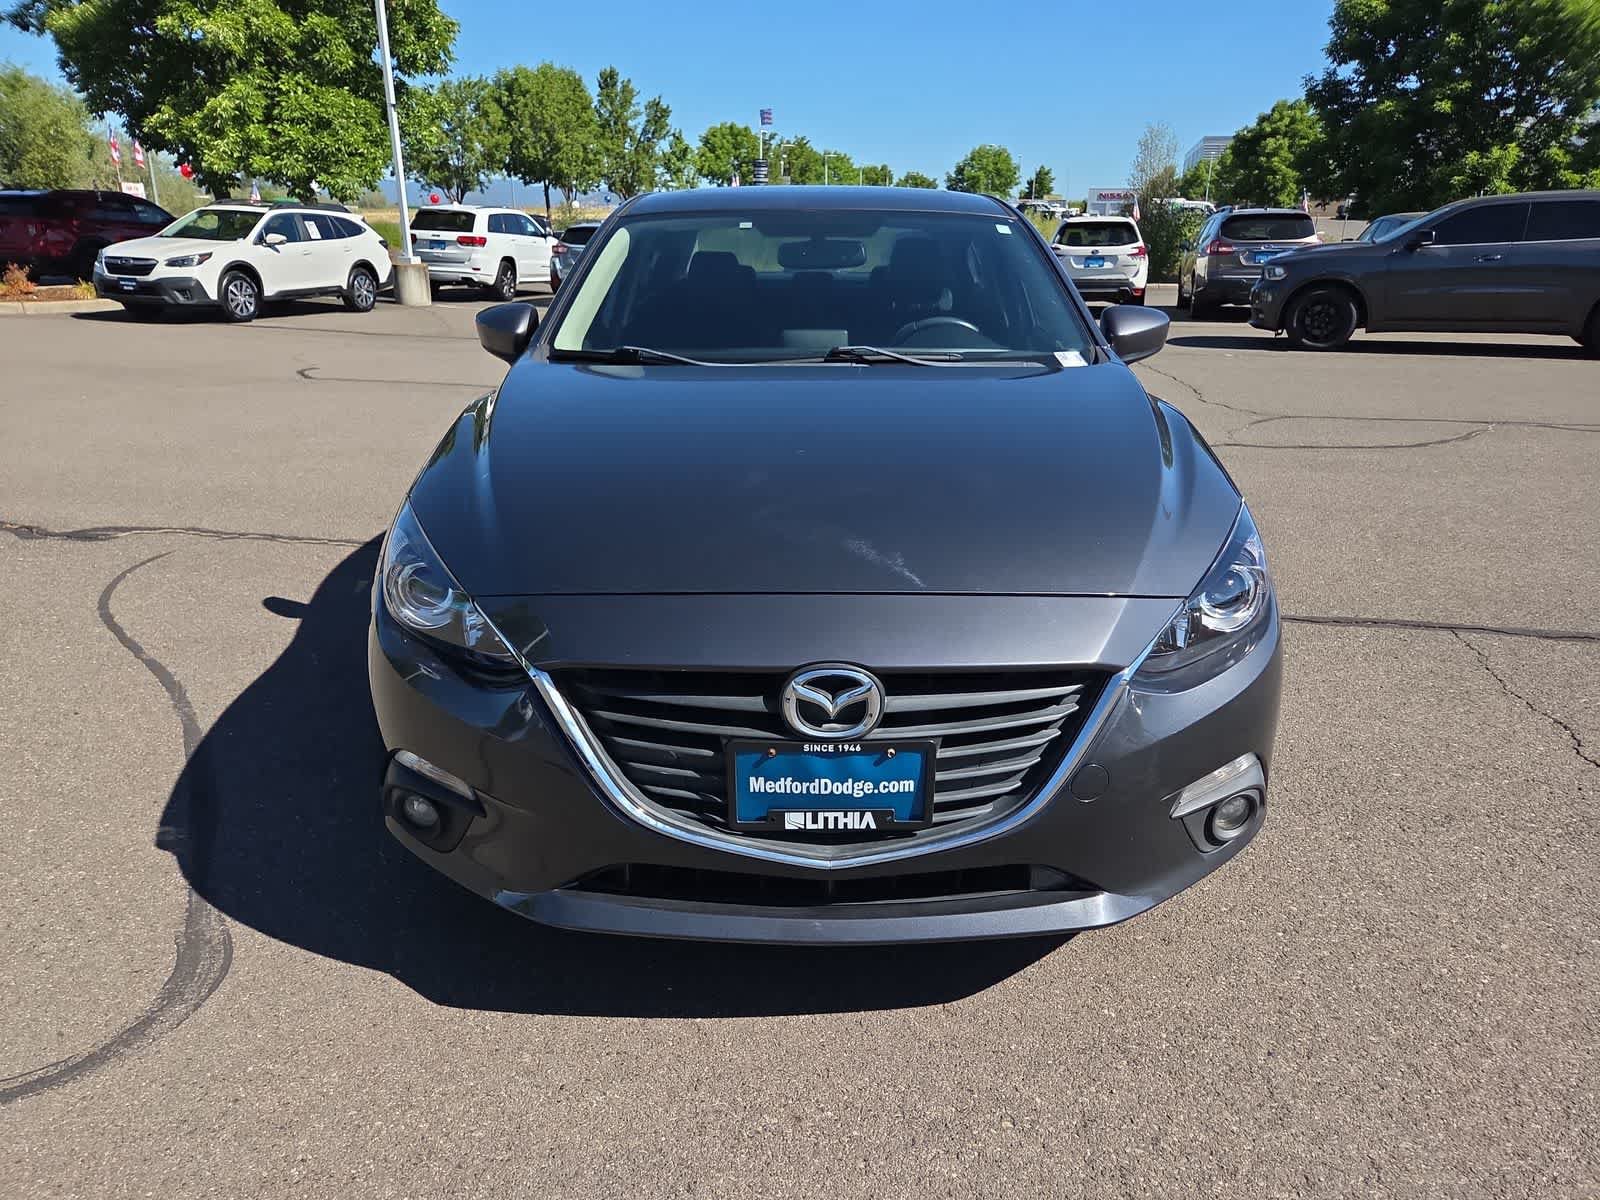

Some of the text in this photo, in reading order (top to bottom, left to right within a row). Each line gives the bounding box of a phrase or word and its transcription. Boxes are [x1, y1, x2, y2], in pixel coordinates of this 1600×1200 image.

[803, 744, 862, 752] SINCE 1946
[749, 776, 915, 797] MedfordDodge.com
[805, 811, 876, 829] LITHIA
